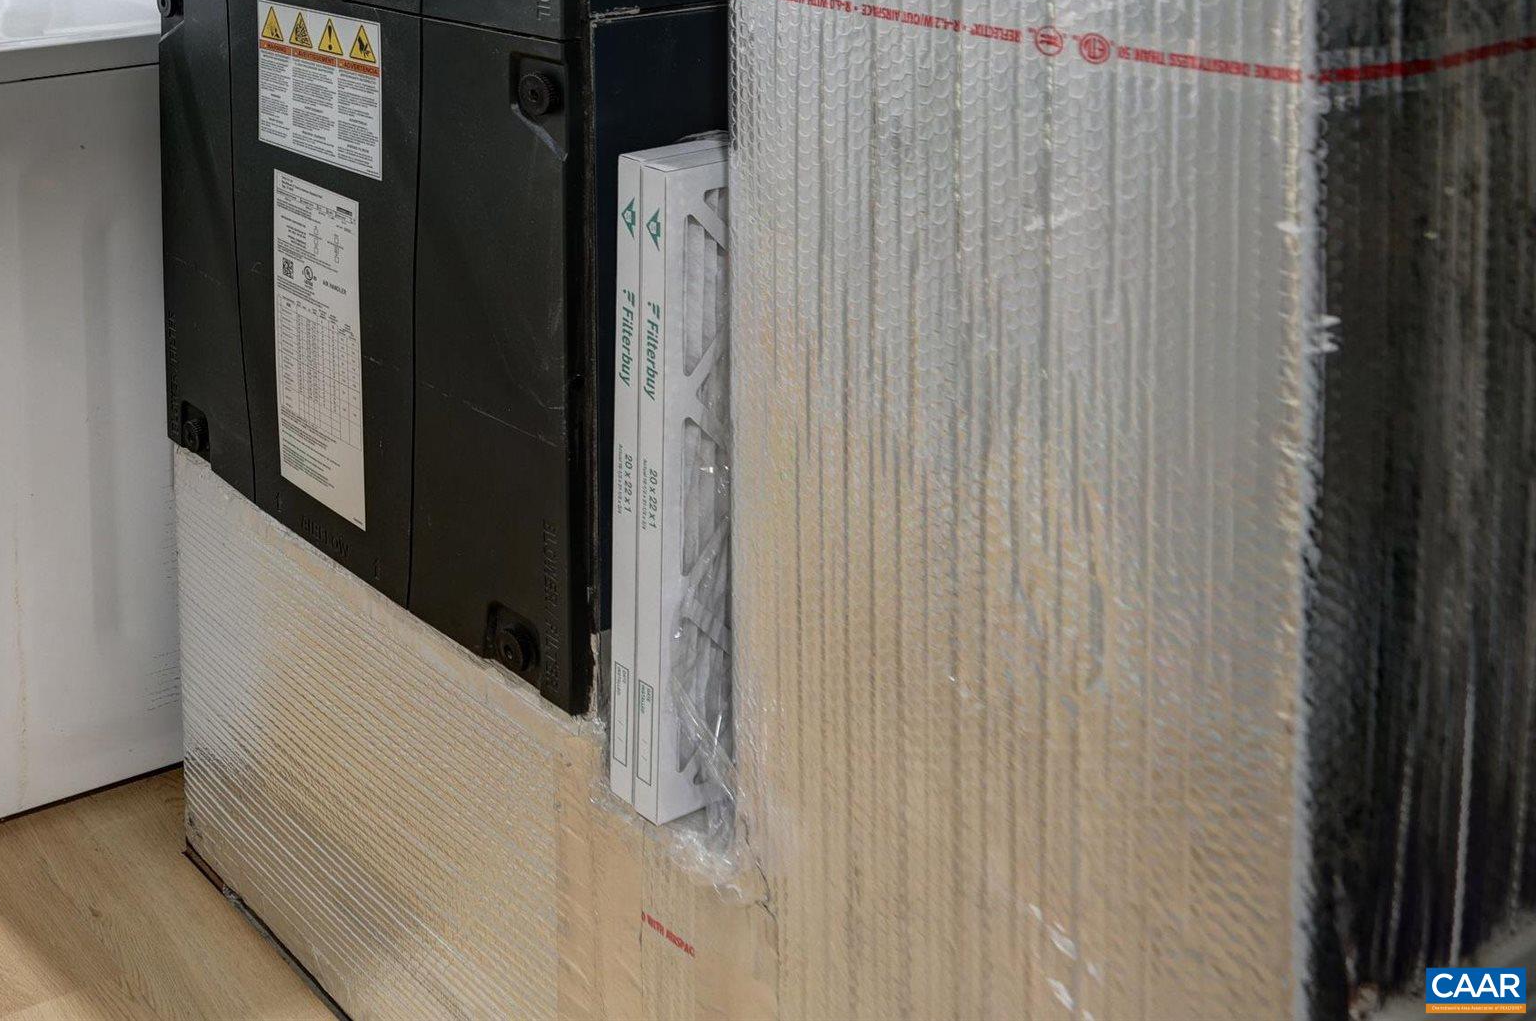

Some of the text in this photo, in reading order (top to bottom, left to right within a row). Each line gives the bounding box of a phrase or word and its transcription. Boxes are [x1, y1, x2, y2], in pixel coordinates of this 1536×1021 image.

[862, 3, 900, 22] AIRSPACE
[901, 11, 934, 28] W/OUT
[619, 306, 634, 387] Filterbuy
[644, 319, 659, 401] Filterbuy
[625, 454, 633, 470] 20
[649, 468, 658, 485] 20
[624, 481, 633, 496] 22
[649, 496, 658, 512] 22
